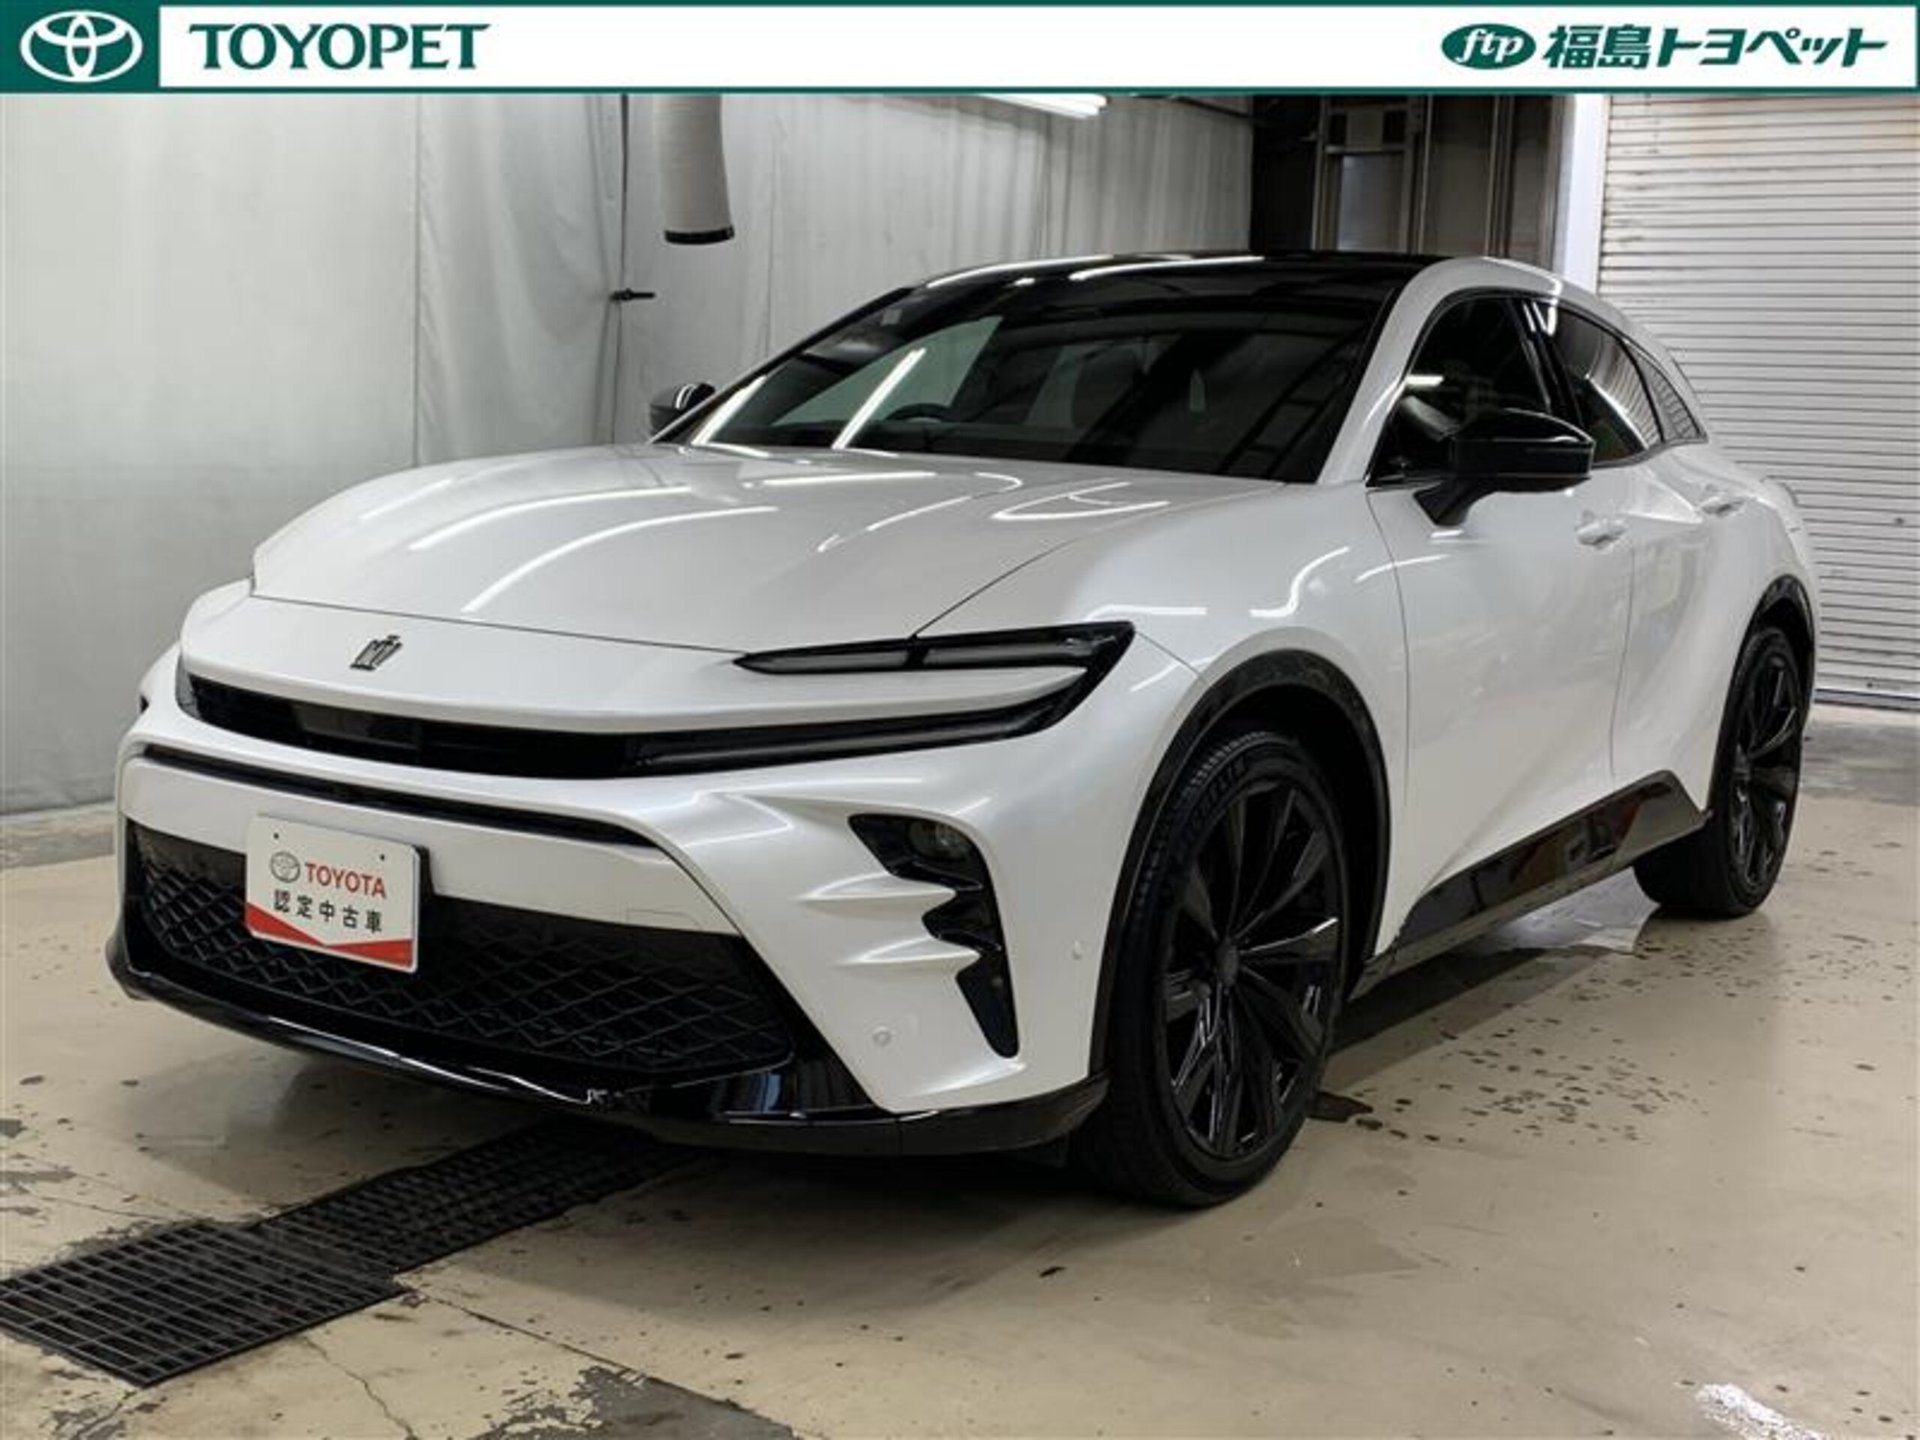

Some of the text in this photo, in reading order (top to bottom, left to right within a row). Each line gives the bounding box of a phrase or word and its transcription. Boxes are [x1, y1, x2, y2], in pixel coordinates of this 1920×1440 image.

[305, 862, 386, 898] TOYOTA
[273, 889, 382, 933] 認定中古車
